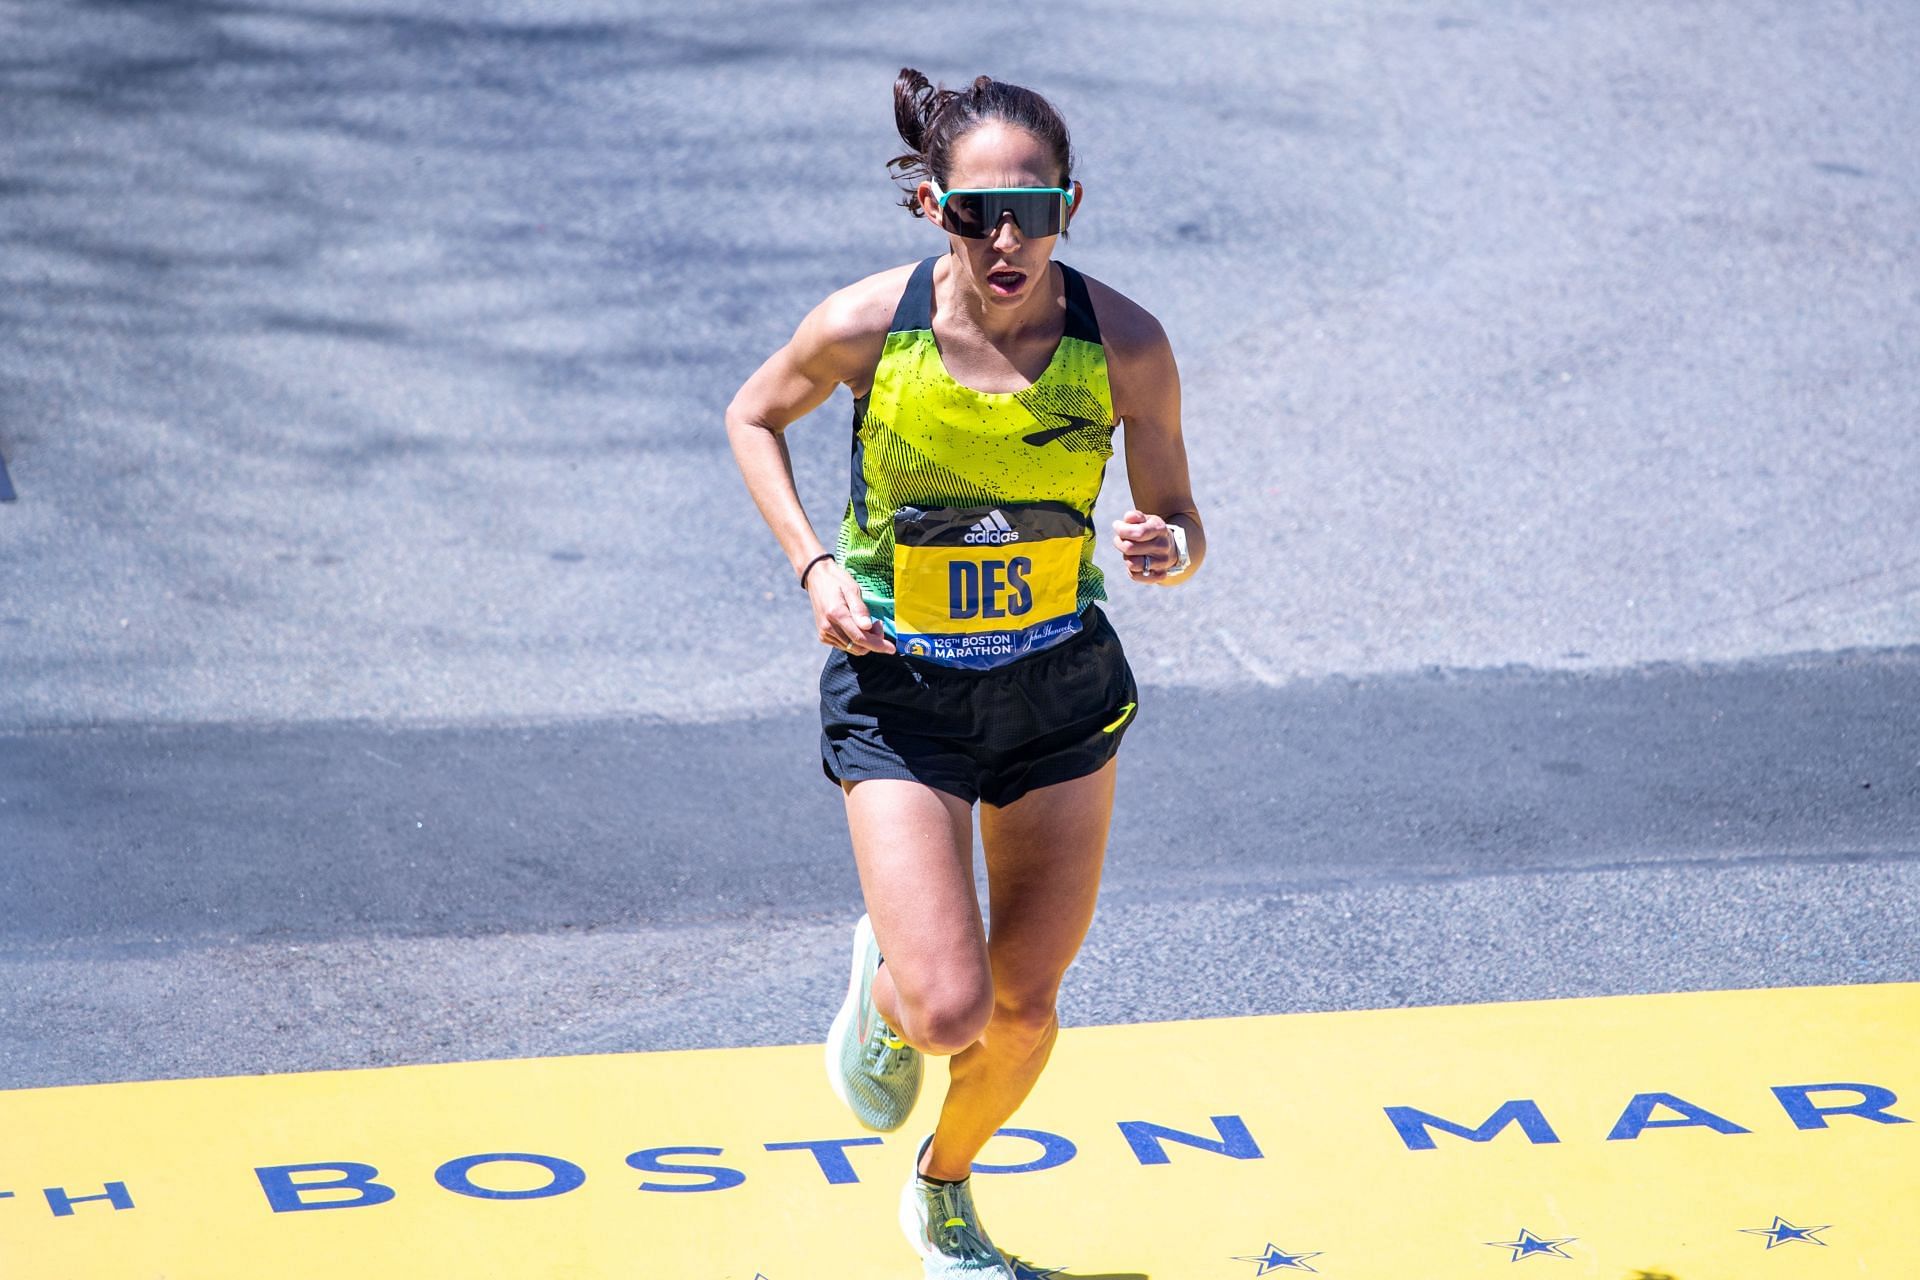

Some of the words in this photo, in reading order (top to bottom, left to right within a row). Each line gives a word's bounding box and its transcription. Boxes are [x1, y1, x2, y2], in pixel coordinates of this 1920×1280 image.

[964, 529, 1019, 544] adidas
[949, 556, 1032, 619] DES
[933, 638, 960, 648] 126TH
[962, 634, 1011, 647] BOSTON
[1022, 629, 1043, 651] John
[0, 1181, 135, 1217] H
[254, 1115, 1265, 1213] BOSTON
[1383, 1082, 1916, 1151] MAR
